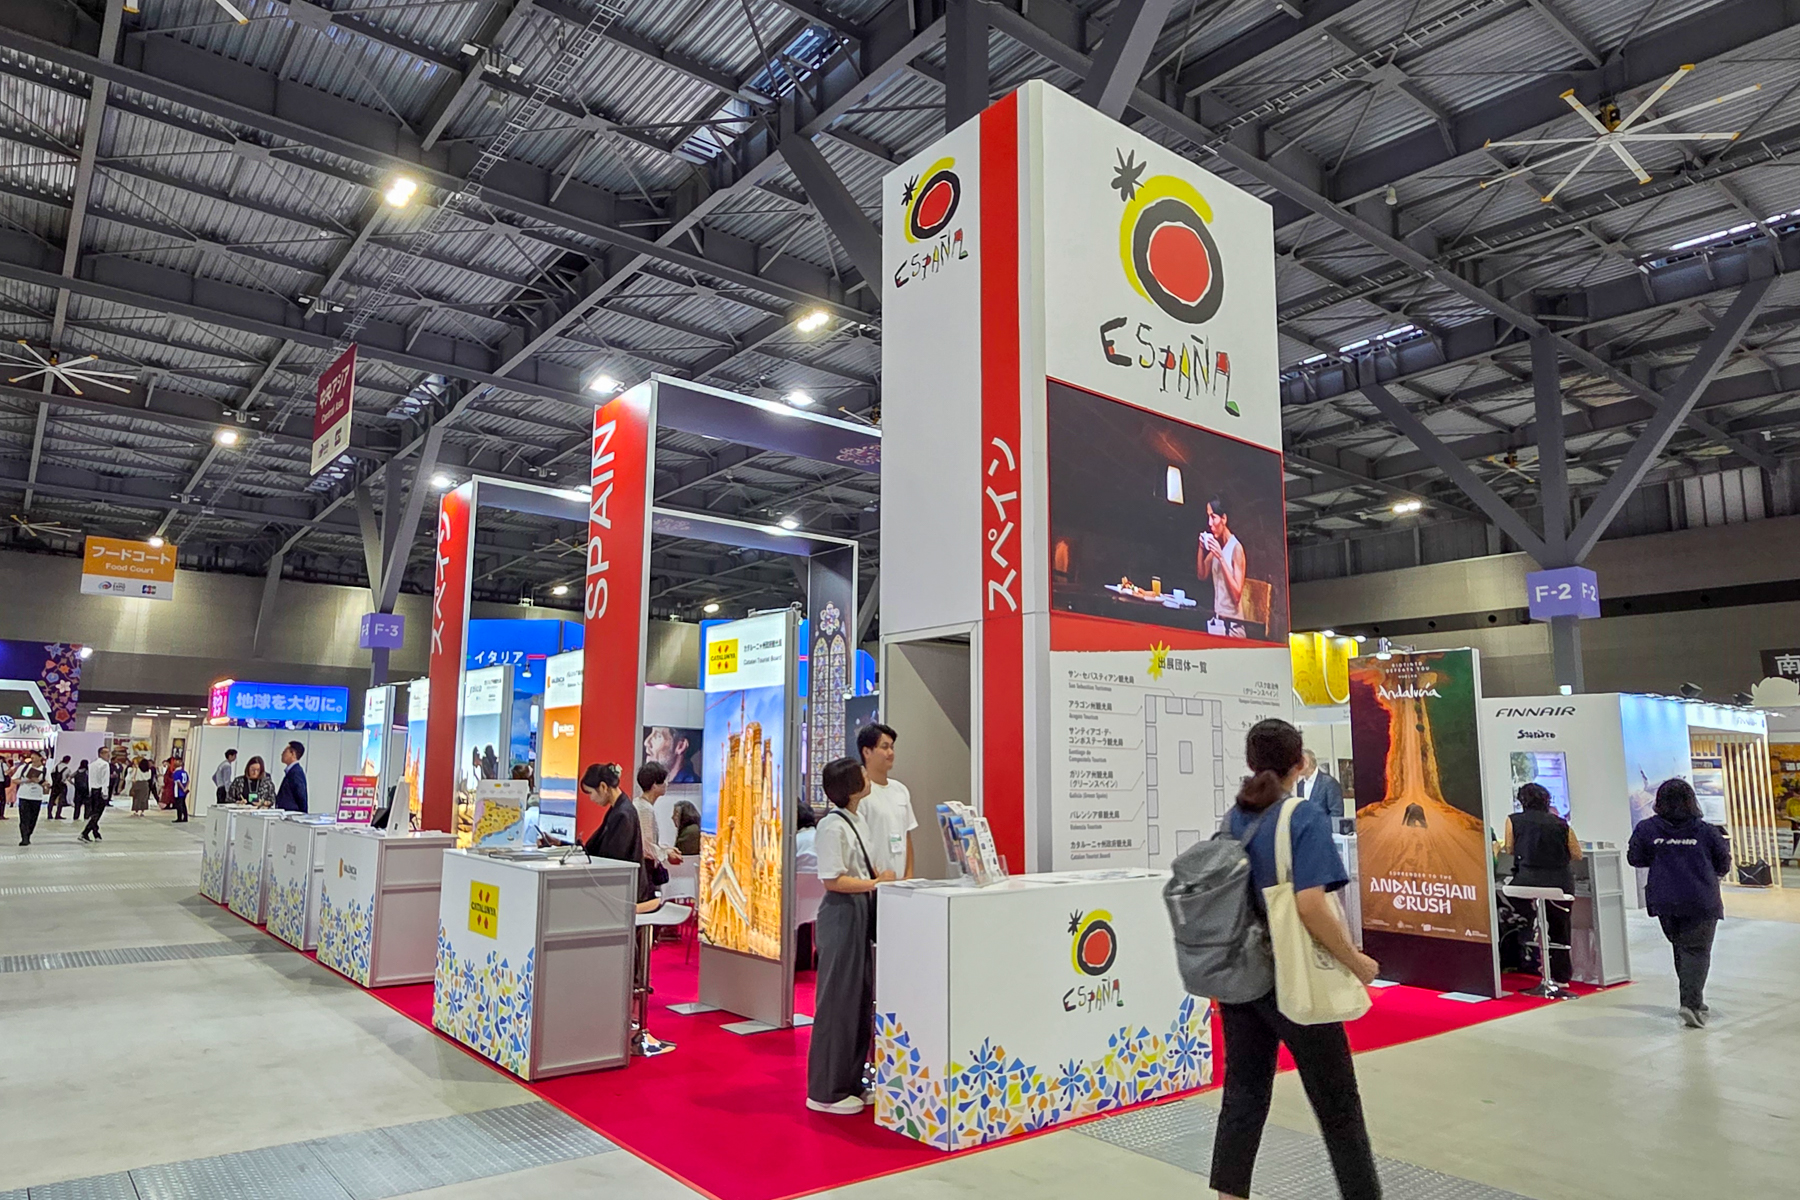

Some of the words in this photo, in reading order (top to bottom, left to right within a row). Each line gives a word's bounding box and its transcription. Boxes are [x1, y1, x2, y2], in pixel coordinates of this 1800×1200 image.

[894, 227, 969, 289] ESPAÑA
[1099, 315, 1241, 417] ESPAÑA
[320, 364, 351, 409] 中央アジア
[585, 419, 617, 620] SPAIN
[985, 437, 1018, 612] スペイン
[92, 545, 171, 565] フードコート
[105, 562, 128, 572] Food
[129, 565, 154, 575] Court
[430, 511, 450, 656] スペイン
[1535, 583, 1573, 603] F-2
[1581, 581, 1597, 602] F-2
[374, 623, 399, 637] F-3
[474, 650, 524, 664] イタリア
[710, 652, 736, 662] CATALUNYA
[1157, 656, 1208, 674] 出展団体一覧
[1774, 653, 1800, 676] 南
[235, 692, 343, 713] 地球を大切に。
[1068, 700, 1112, 711] アラゴン州観光局
[1495, 706, 1576, 718] FINNAIR
[1069, 770, 1114, 779] ガリシア州観光局
[1440, 873, 1452, 881] THE
[1369, 876, 1477, 901] ANDALUSIAN
[471, 901, 497, 917] CATALUNYA
[1392, 894, 1452, 915] CRUSH
[1062, 976, 1124, 1014] ESPAÑA
